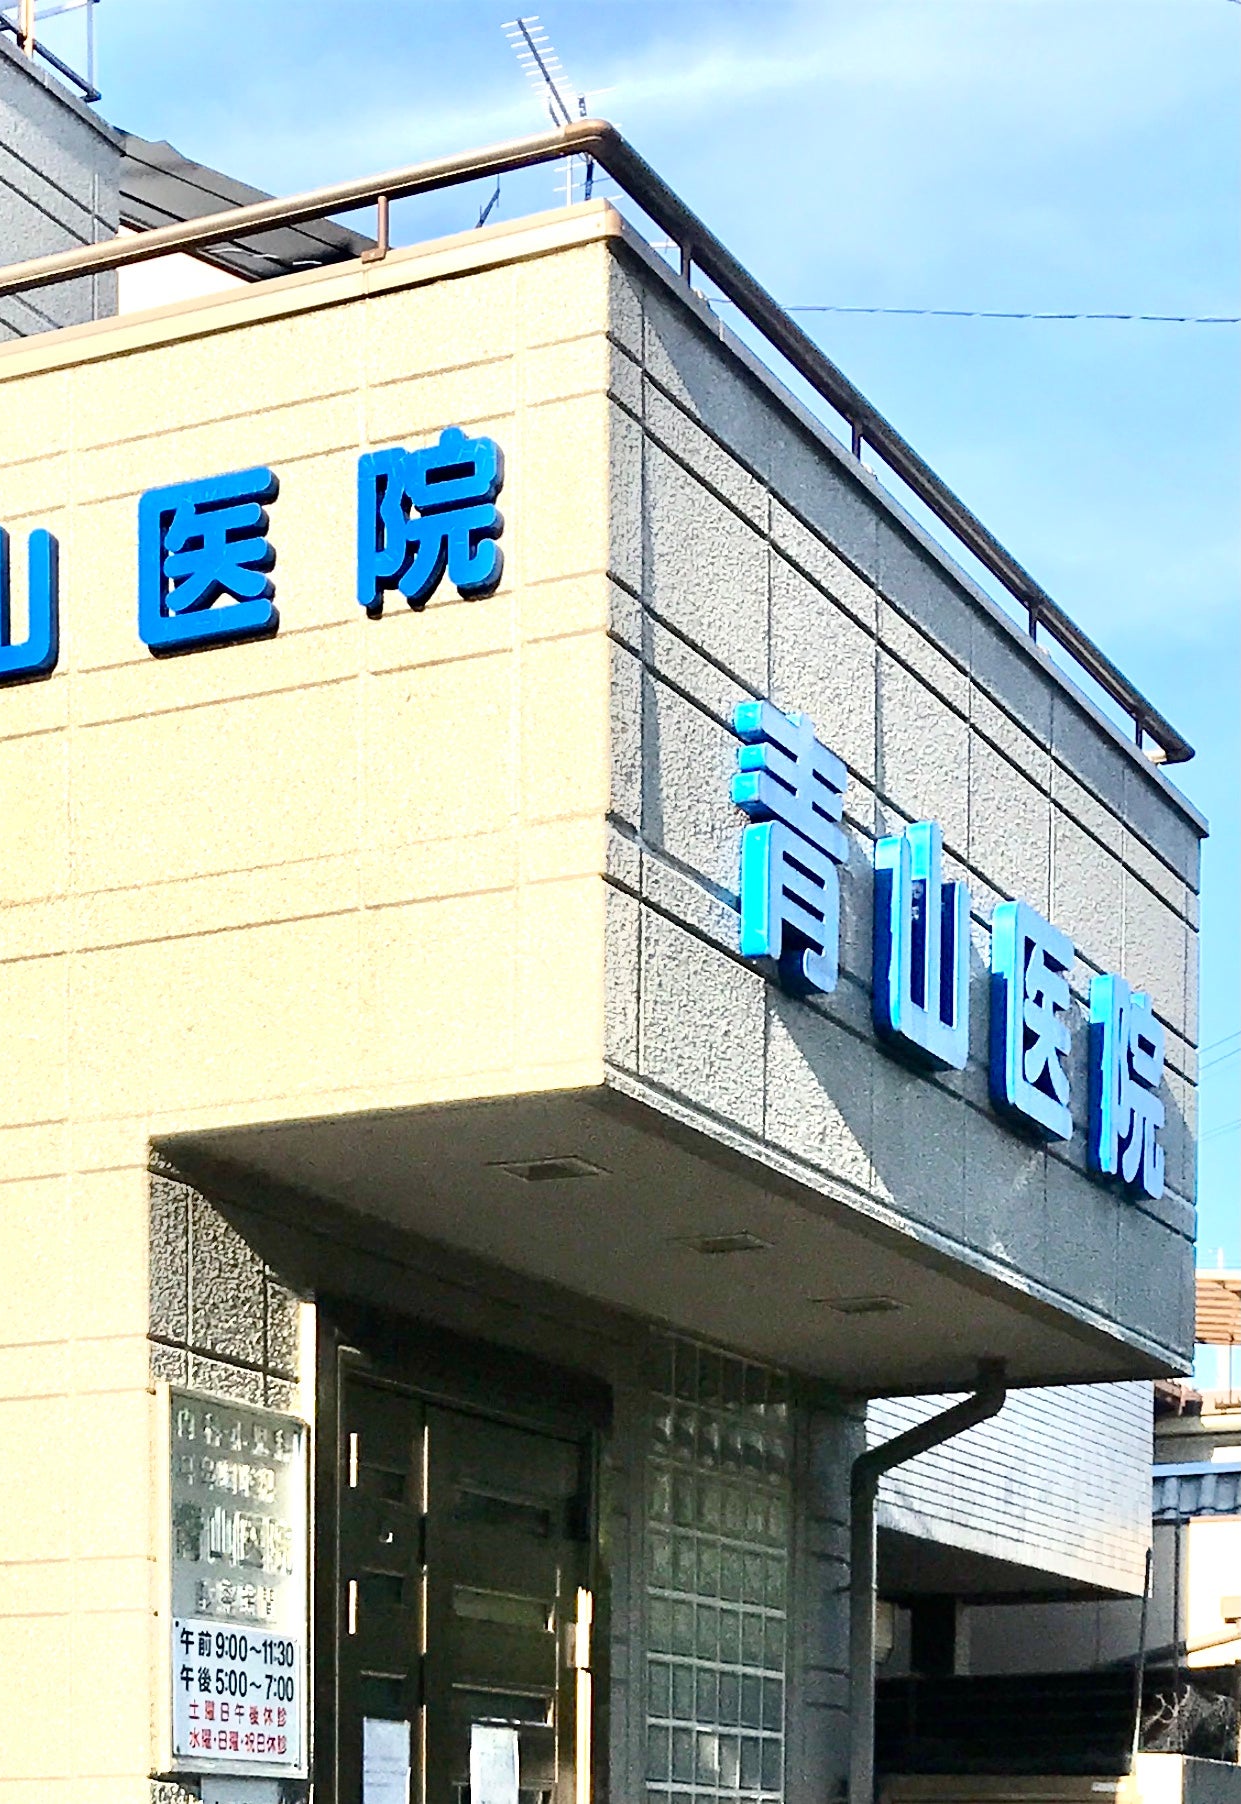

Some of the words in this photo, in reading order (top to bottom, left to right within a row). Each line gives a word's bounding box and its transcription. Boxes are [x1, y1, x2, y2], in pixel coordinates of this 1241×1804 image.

[732, 700, 1165, 1199] 青山医院
[189, 1699, 287, 1728] 土曜日午後休診
